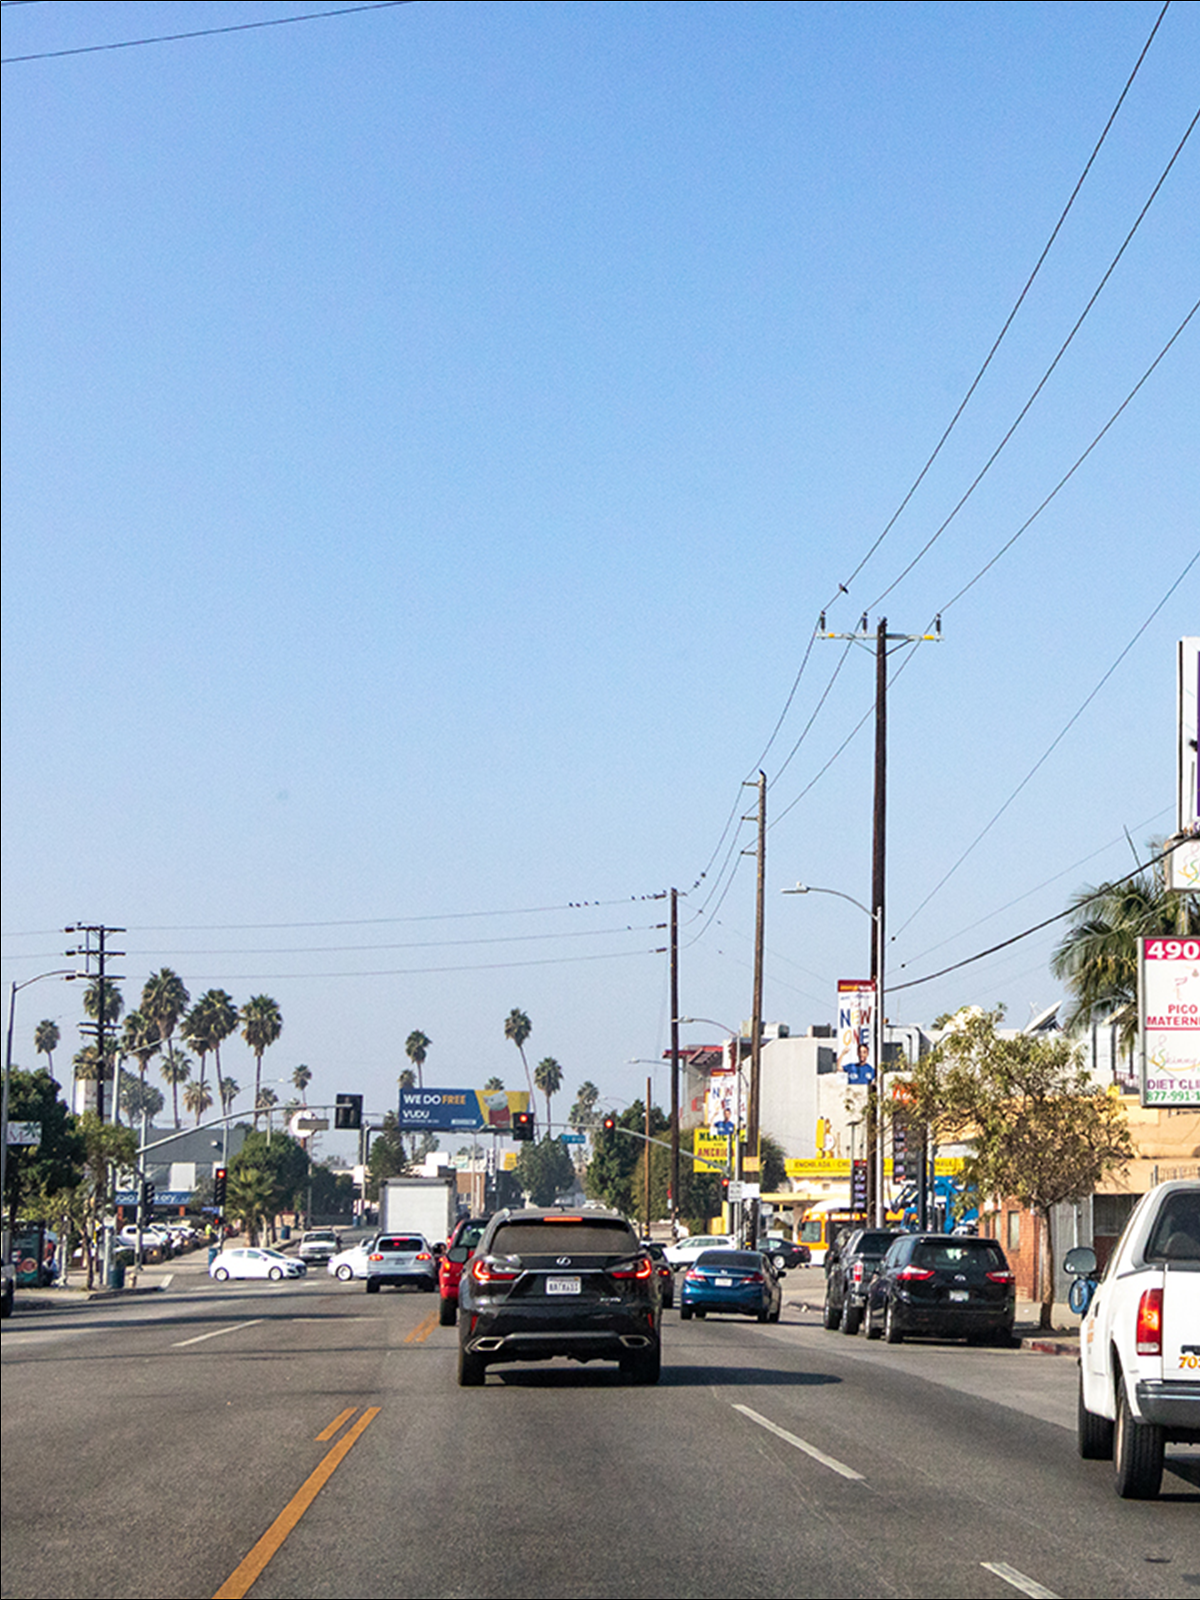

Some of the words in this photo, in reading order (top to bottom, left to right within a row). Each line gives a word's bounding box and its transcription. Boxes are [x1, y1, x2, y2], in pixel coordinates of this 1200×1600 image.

[1168, 1004, 1198, 1015] PICO
[840, 1006, 872, 1029] NEW
[843, 1026, 870, 1047] ONE
[1147, 1079, 1175, 1090] DIET
[403, 1094, 421, 1105] WE
[423, 1094, 441, 1105] DO
[442, 1095, 466, 1105] FREE
